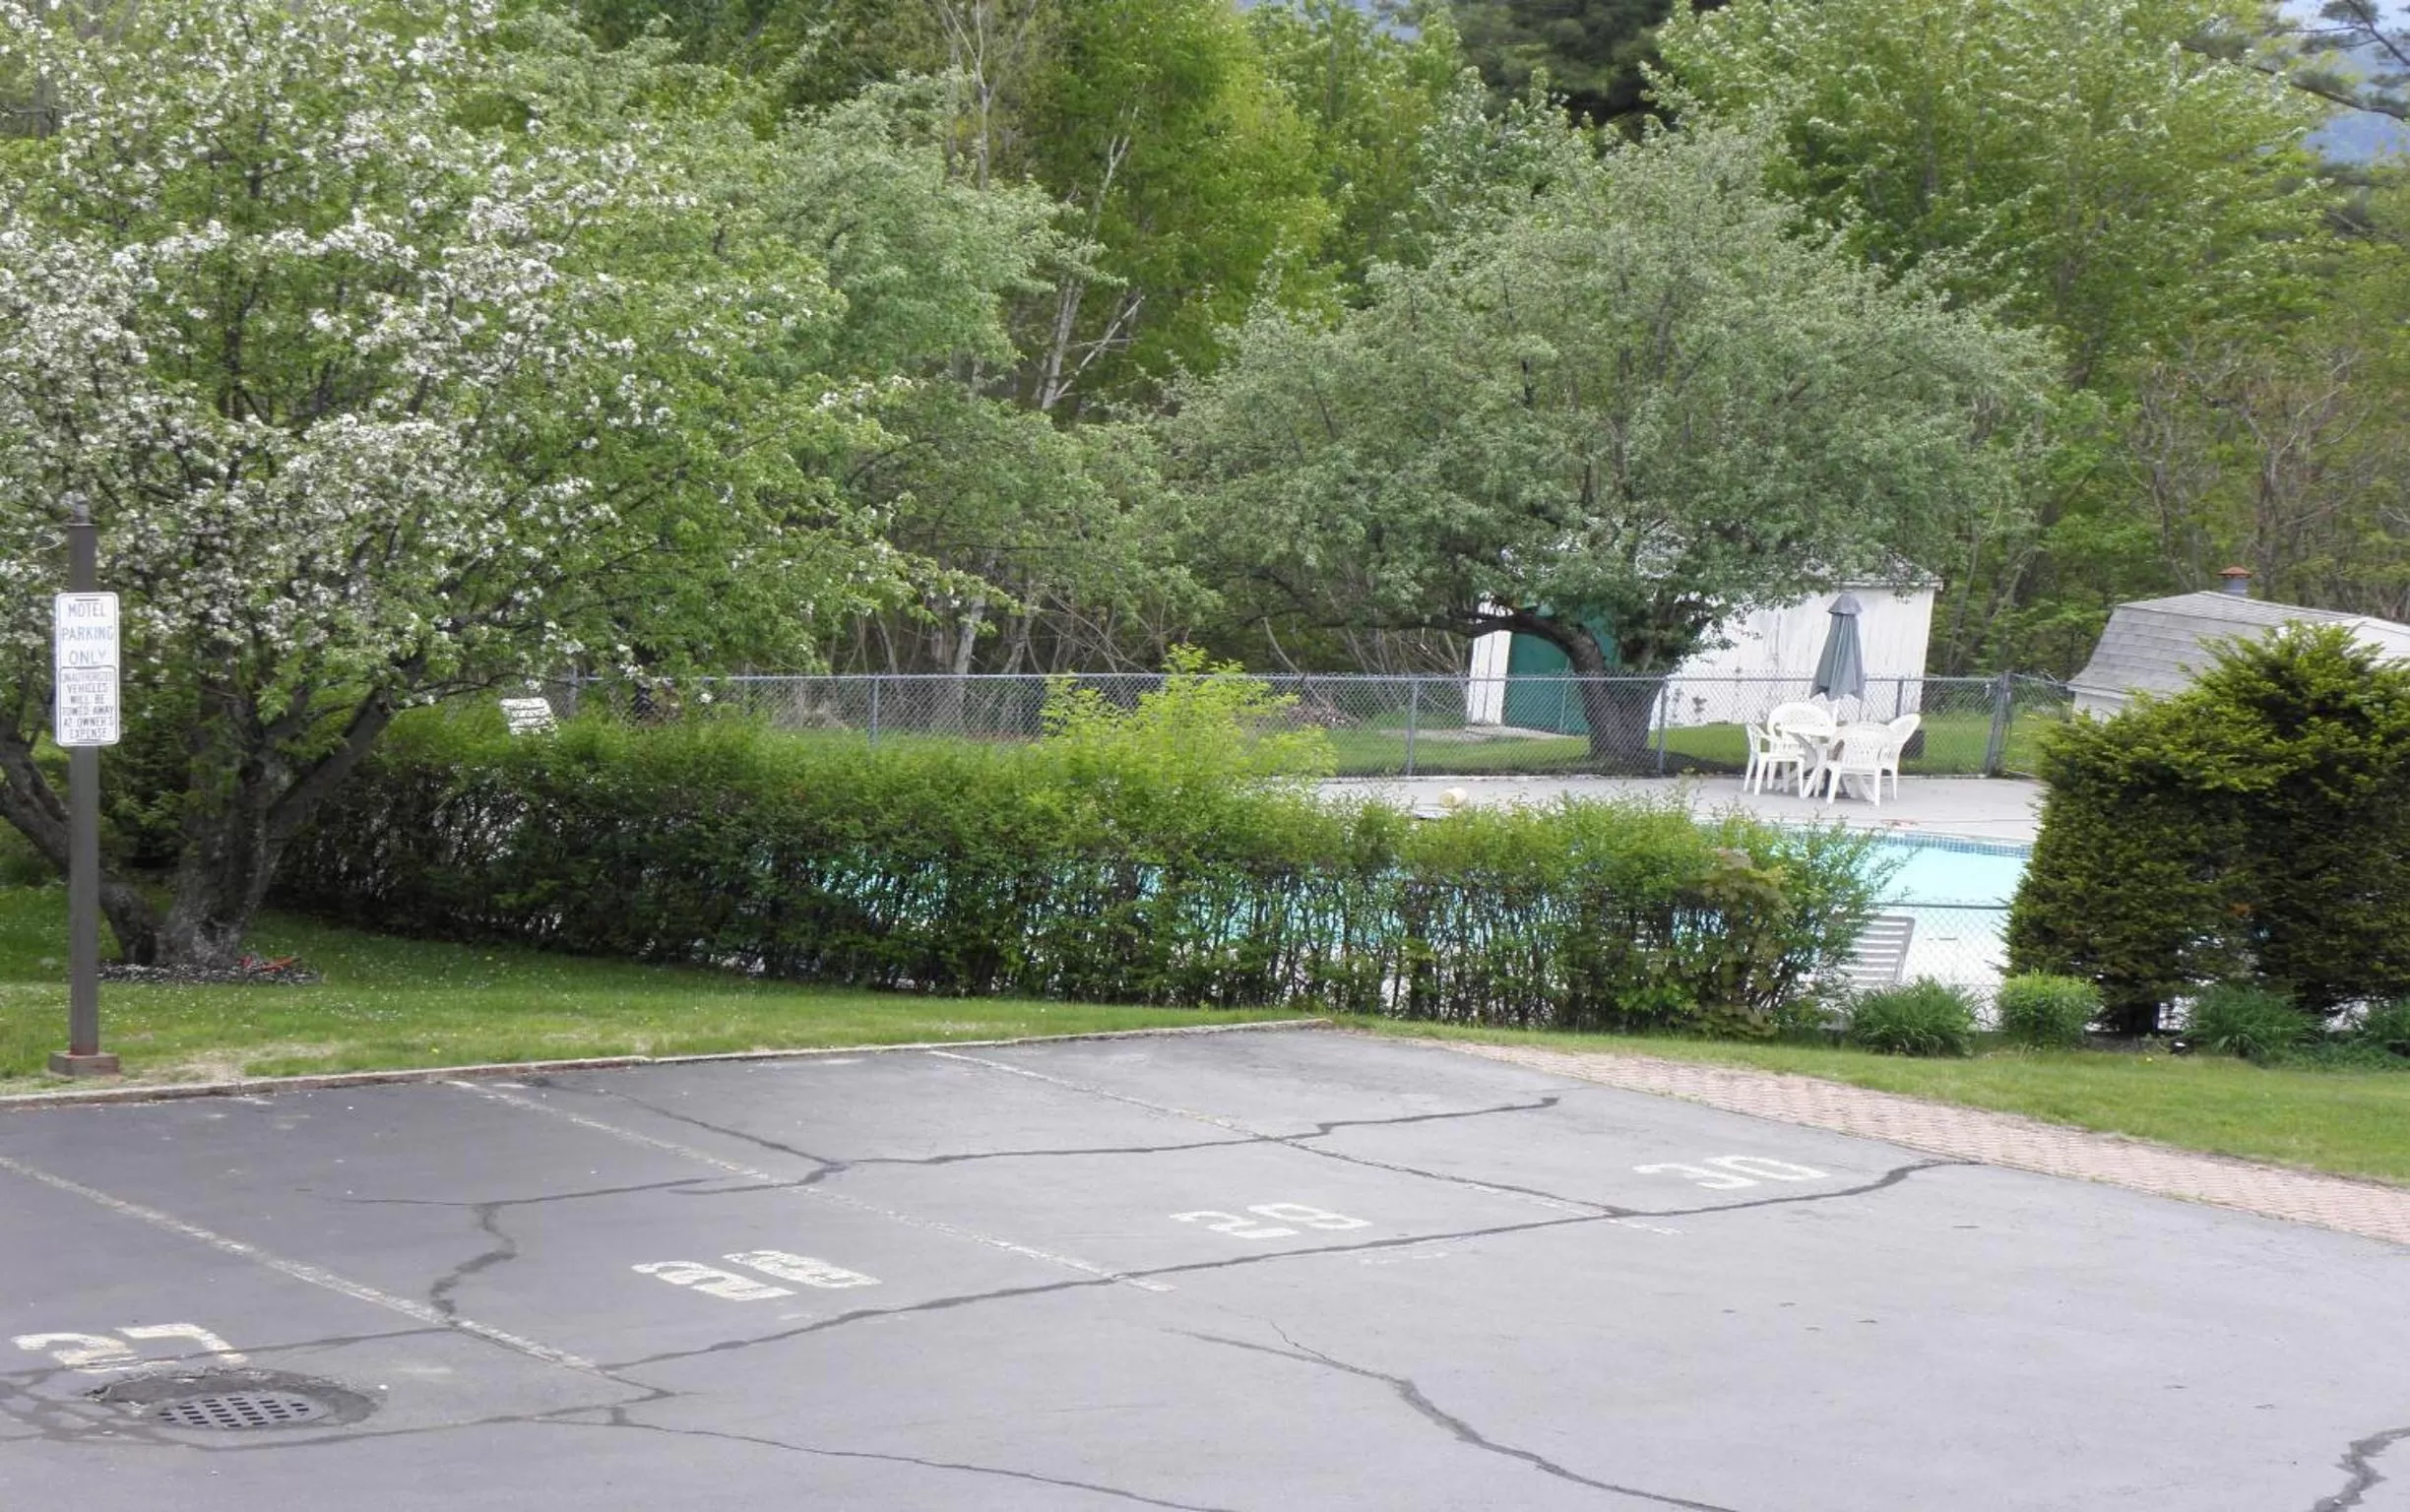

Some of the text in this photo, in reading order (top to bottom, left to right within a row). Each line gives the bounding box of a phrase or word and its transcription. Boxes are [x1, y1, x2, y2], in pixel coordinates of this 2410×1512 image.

[68, 601, 106, 618] MOTEL
[62, 625, 113, 641] PARKING
[68, 648, 107, 665] ONLY
[1632, 1155, 1831, 1189] 30
[11, 1323, 248, 1373] 27
